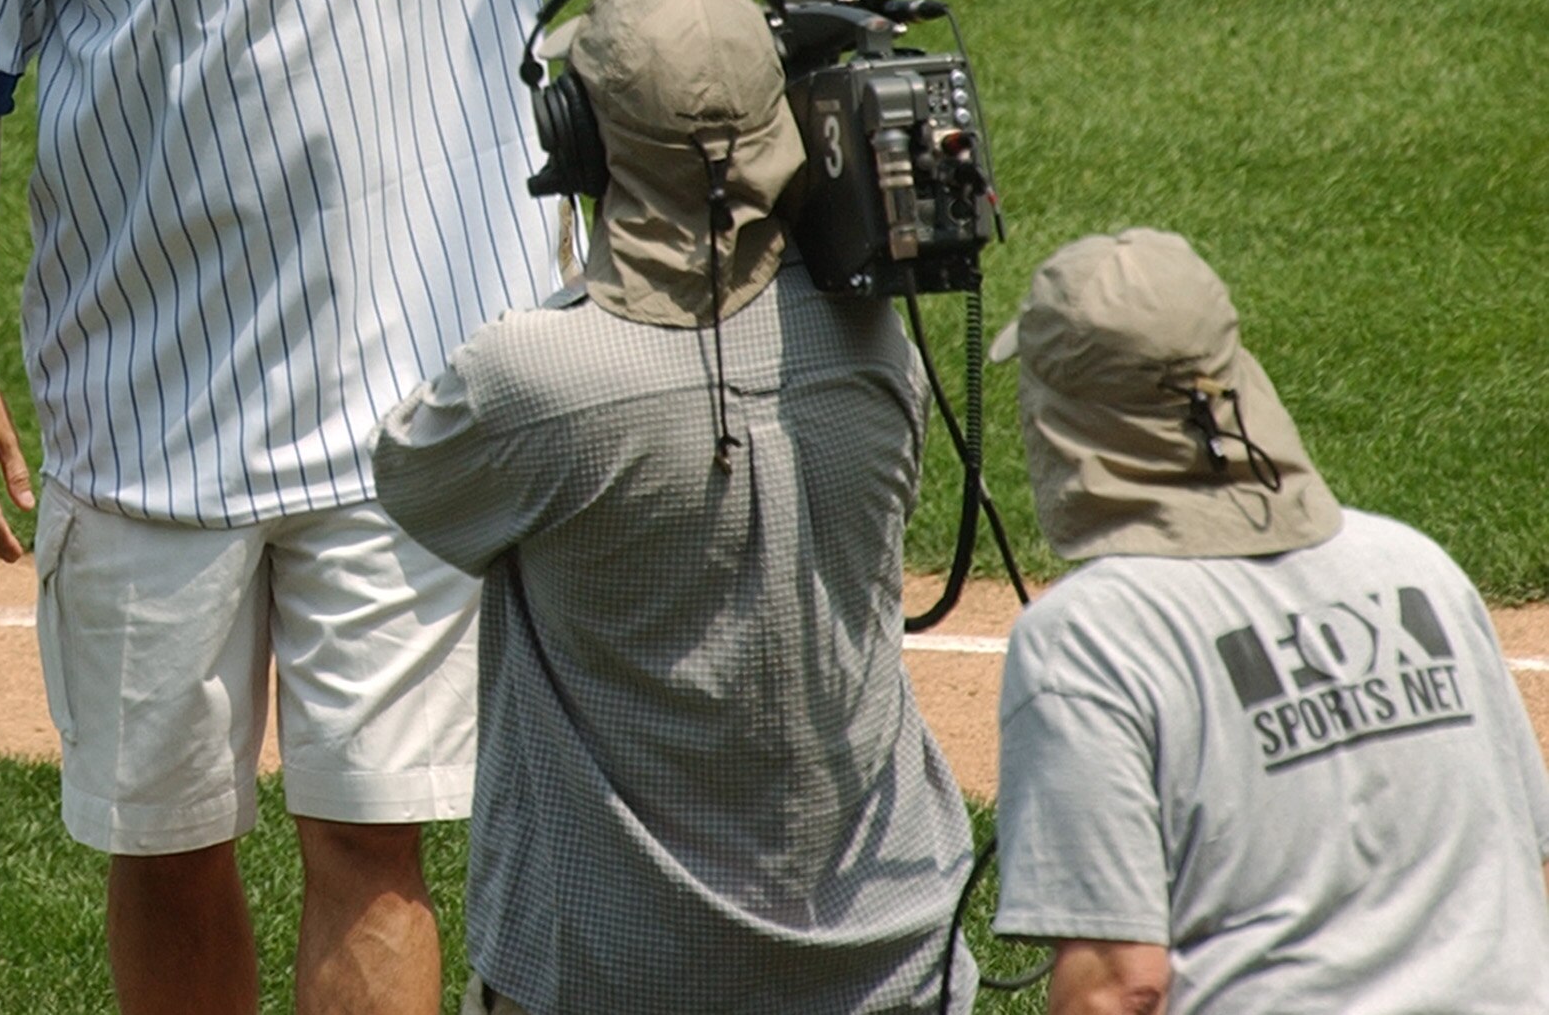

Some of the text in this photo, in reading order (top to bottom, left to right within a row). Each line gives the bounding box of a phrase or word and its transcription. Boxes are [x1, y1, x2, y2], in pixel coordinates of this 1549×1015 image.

[824, 115, 843, 179] 3
[1239, 587, 1441, 700] FOX
[1254, 665, 1464, 756] SPORTS NET
